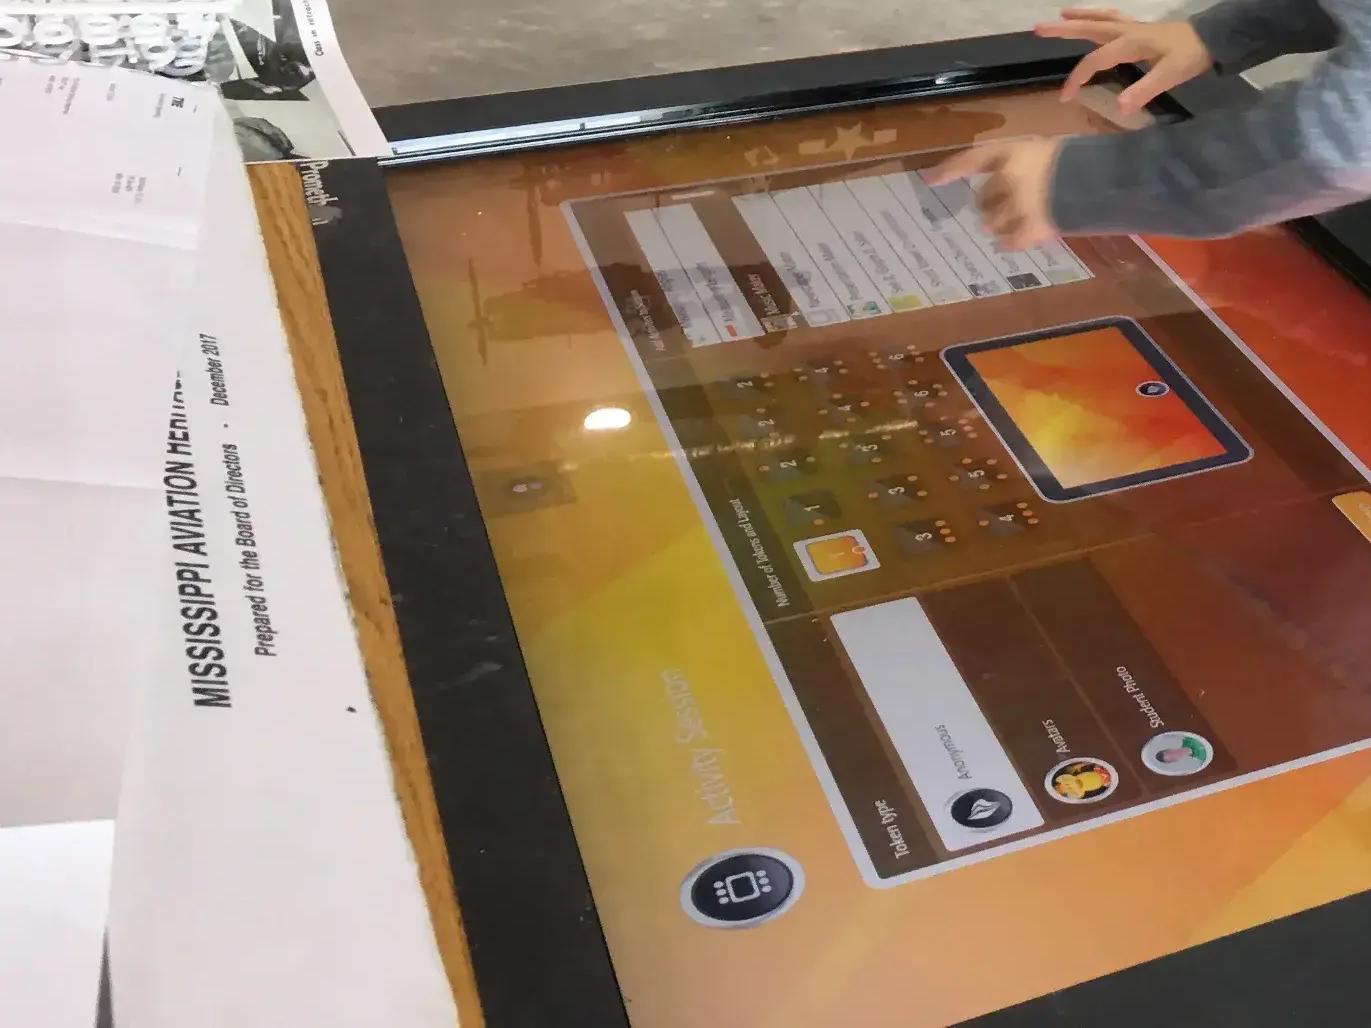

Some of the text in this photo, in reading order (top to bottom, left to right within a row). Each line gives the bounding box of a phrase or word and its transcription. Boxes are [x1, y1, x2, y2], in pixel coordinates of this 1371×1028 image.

[163, 460, 208, 557] AVIATION
[199, 332, 279, 657] Prepared for the Board of Directors December 2017
[729, 498, 790, 607] Number of Tokens and Layout
[175, 562, 232, 708] MISSISSIPPI
[1042, 719, 1070, 754] Avatars
[1116, 666, 1165, 729] Student Photo
[659, 668, 742, 825] Activity Session
[935, 724, 972, 780] Anonymous
[875, 799, 910, 859] Token type
